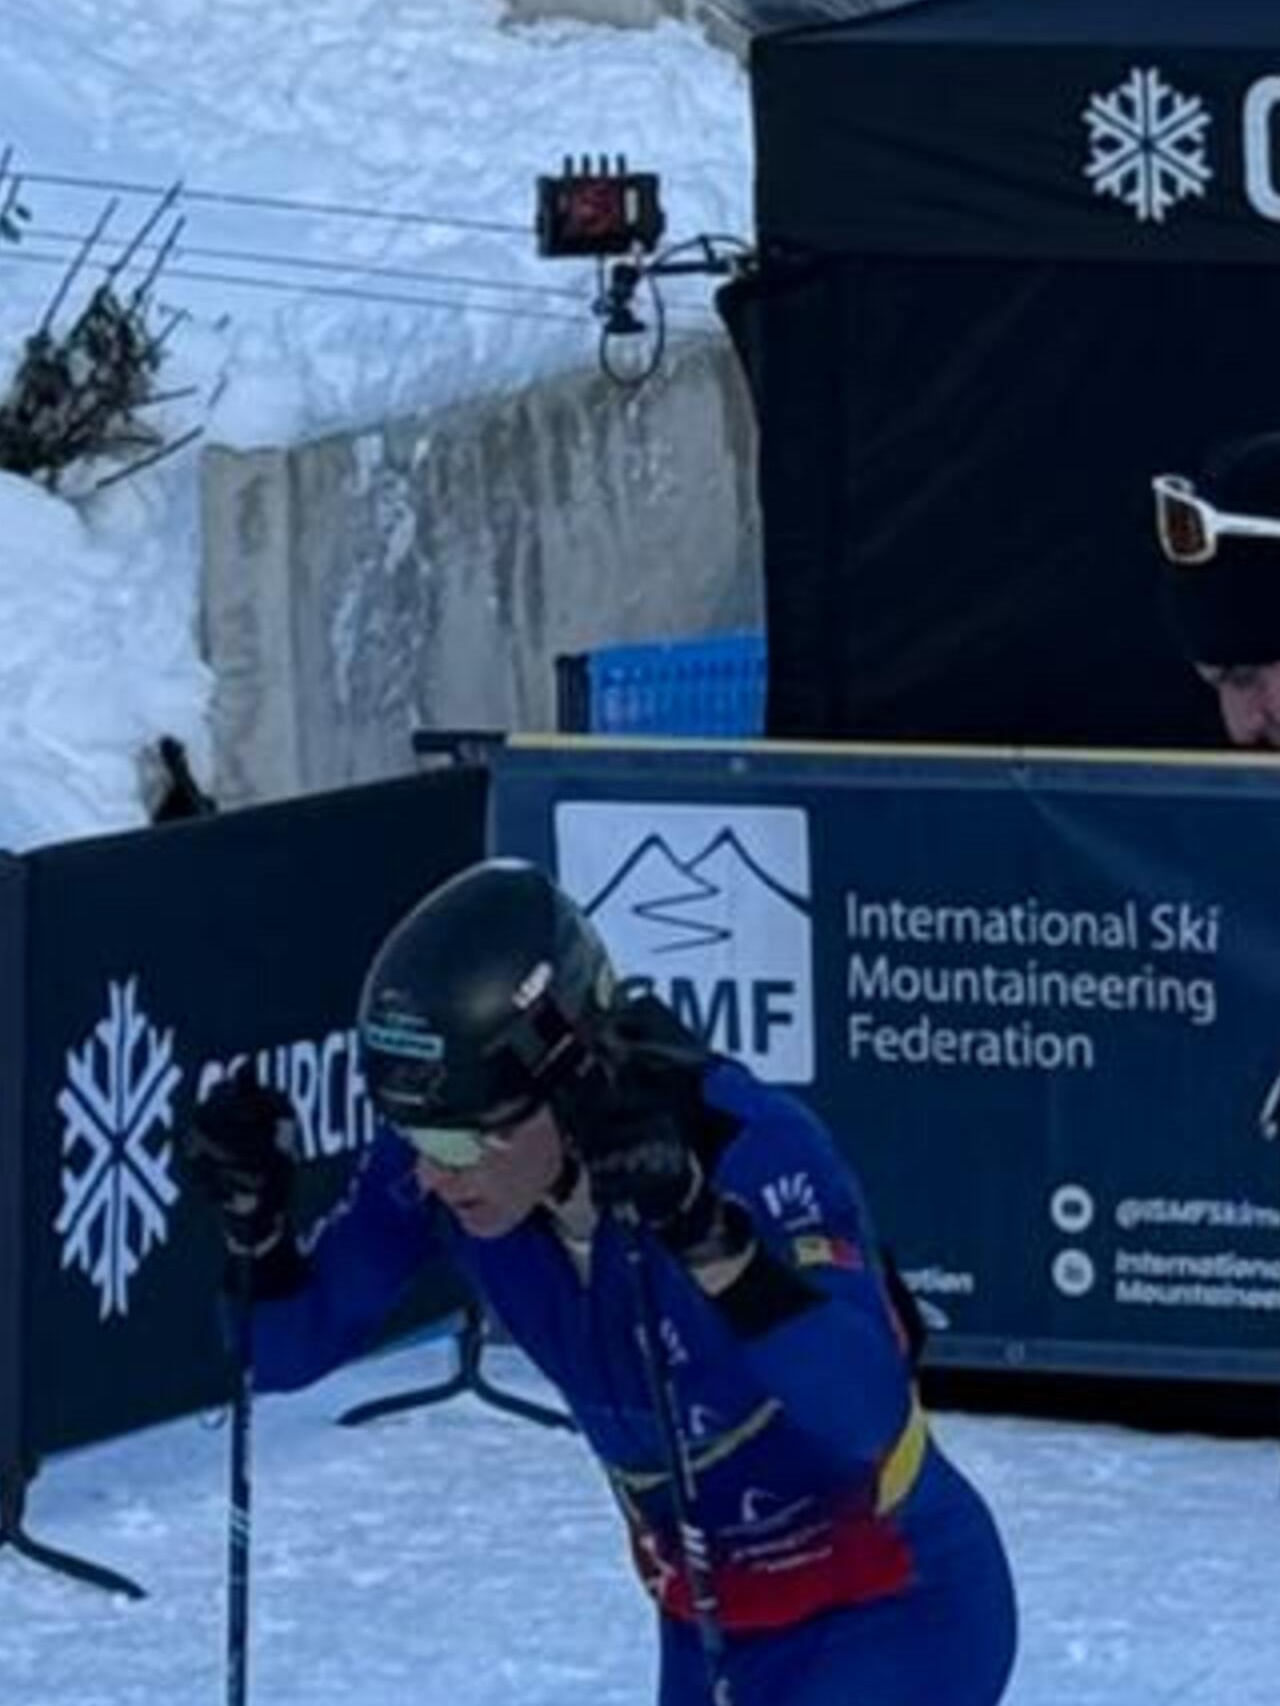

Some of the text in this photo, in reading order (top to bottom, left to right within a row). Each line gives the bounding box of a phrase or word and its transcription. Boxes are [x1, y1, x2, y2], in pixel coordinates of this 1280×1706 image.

[847, 892, 1219, 953] International Ski
[618, 975, 796, 1055] MF
[847, 954, 1218, 1026] Mountaineering
[848, 1014, 1094, 1070] Federation
